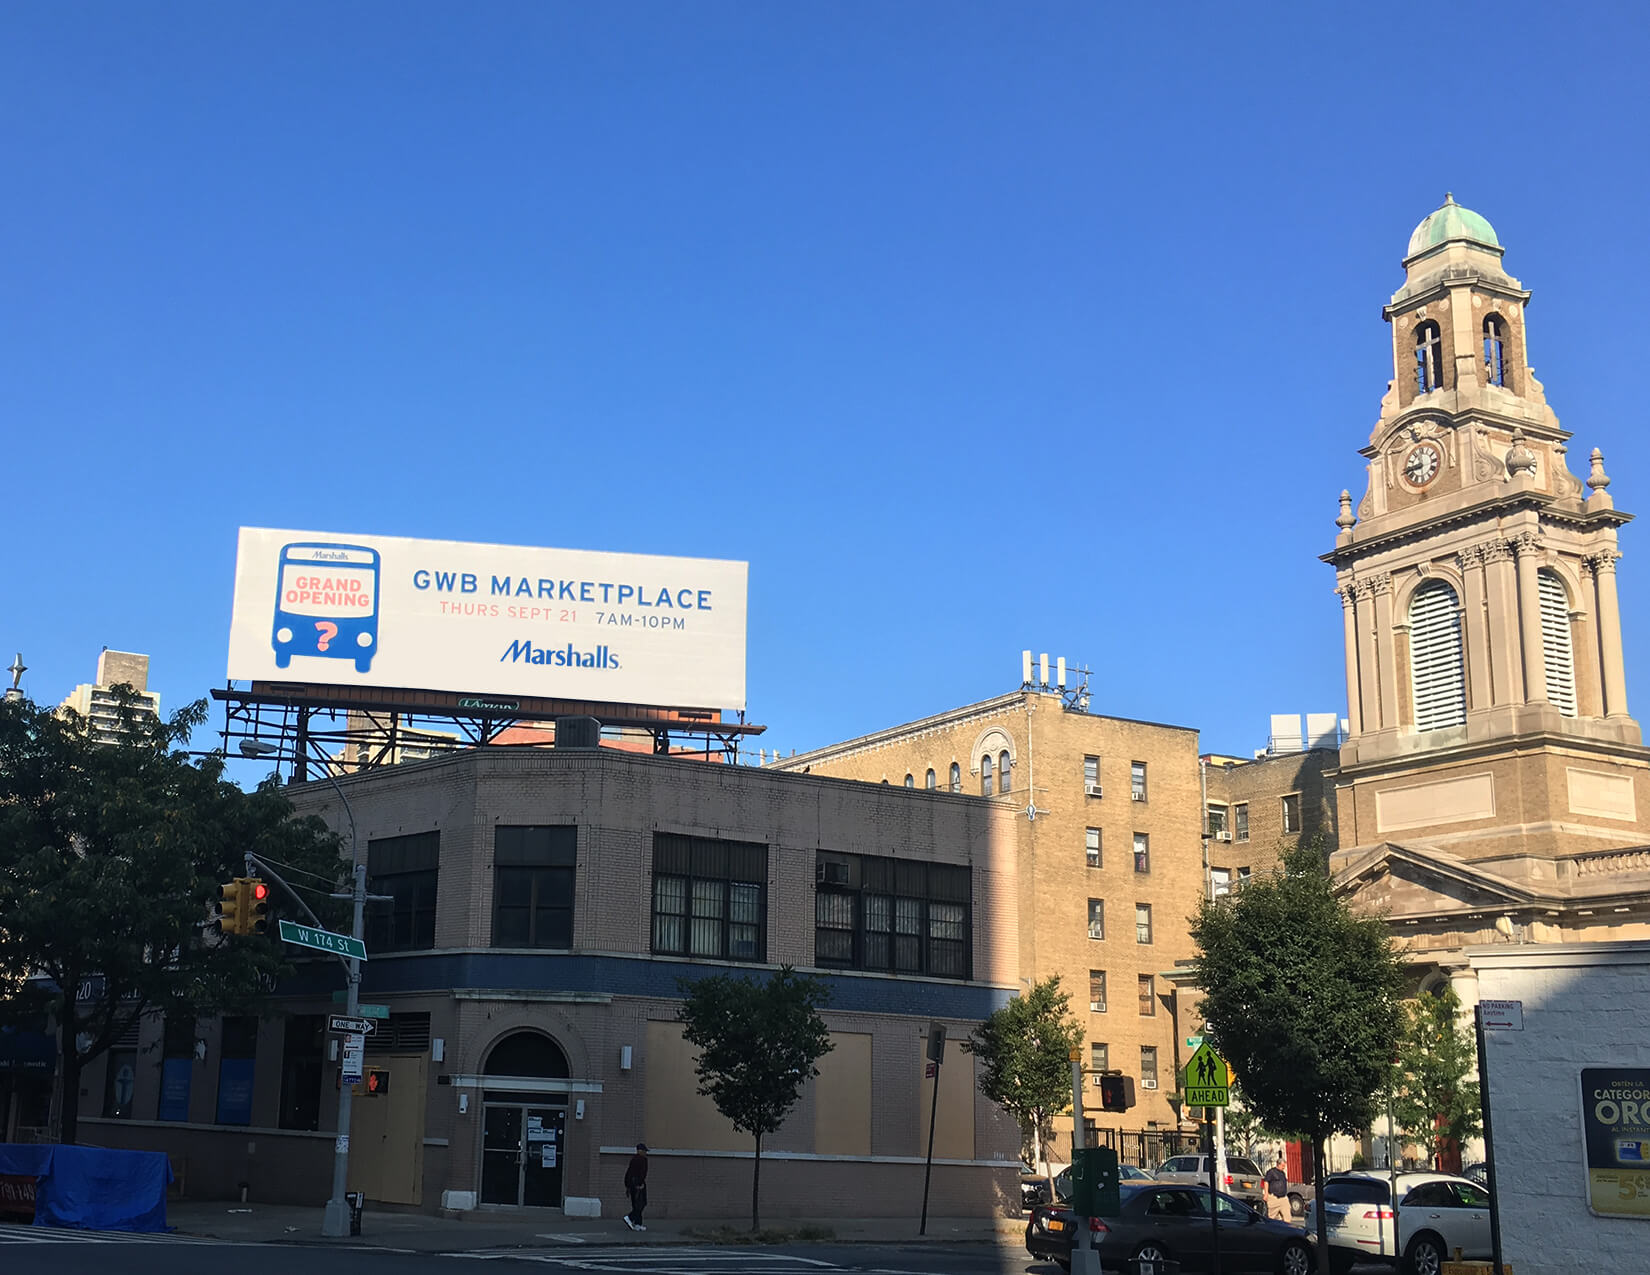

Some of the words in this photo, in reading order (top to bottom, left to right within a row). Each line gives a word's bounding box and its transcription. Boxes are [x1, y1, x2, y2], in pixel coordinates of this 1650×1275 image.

[312, 551, 349, 560] Marshalls
[296, 576, 362, 592] GRAND
[413, 570, 478, 594] GWB
[490, 575, 712, 611] MARKETPLACE
[286, 590, 370, 607] OPENING
[440, 601, 499, 617] THURS
[507, 606, 553, 621] SEPT
[560, 609, 576, 622] 21
[595, 612, 685, 630] 7AM-10PM
[500, 639, 619, 669] Marshalls
[298, 929, 309, 942] W
[314, 933, 333, 948] 174
[337, 939, 350, 952] St
[335, 1020, 350, 1028] ONE
[355, 1023, 370, 1031] WAY
[1191, 1090, 1224, 1102] AHEAD
